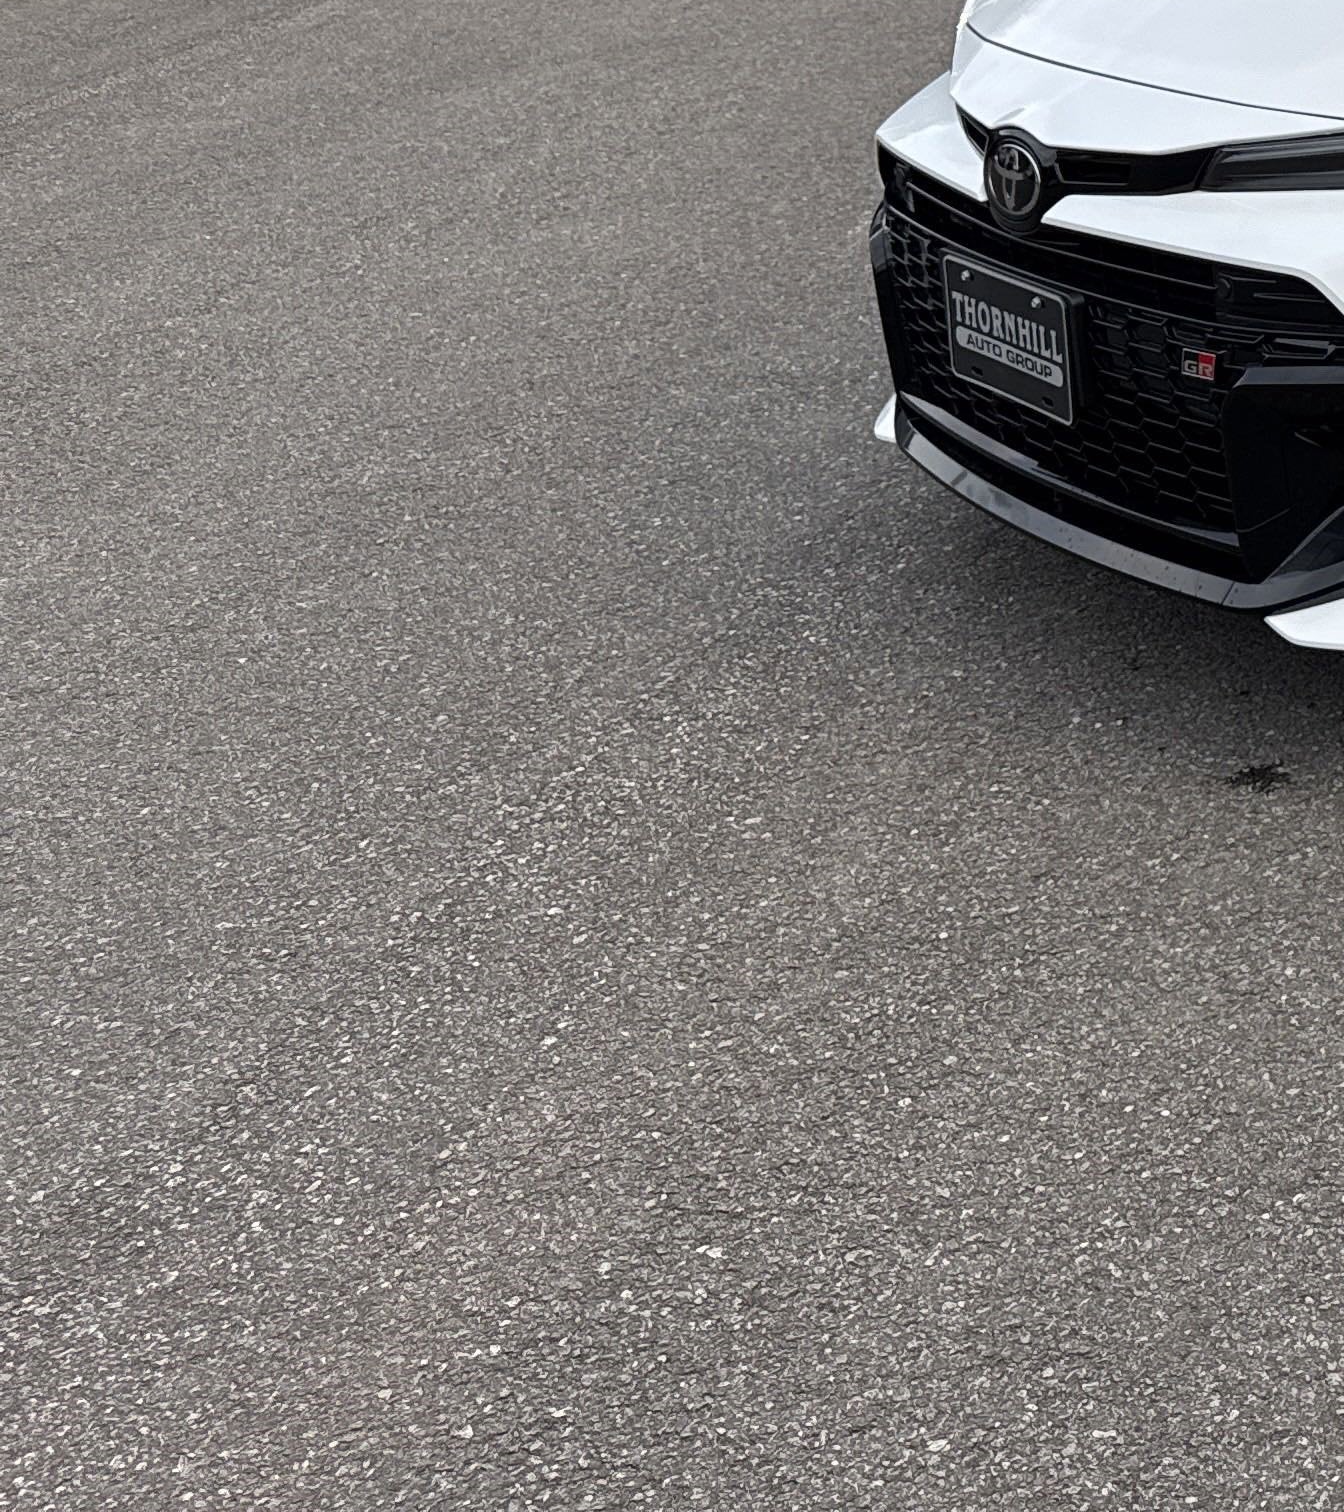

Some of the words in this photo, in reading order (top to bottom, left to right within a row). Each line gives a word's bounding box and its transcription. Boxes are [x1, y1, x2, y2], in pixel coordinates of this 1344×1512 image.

[952, 291, 1064, 364] THORNHILL
[967, 333, 1002, 357] AUTO
[1006, 349, 1053, 379] GROUP
[1184, 359, 1214, 377] GR
